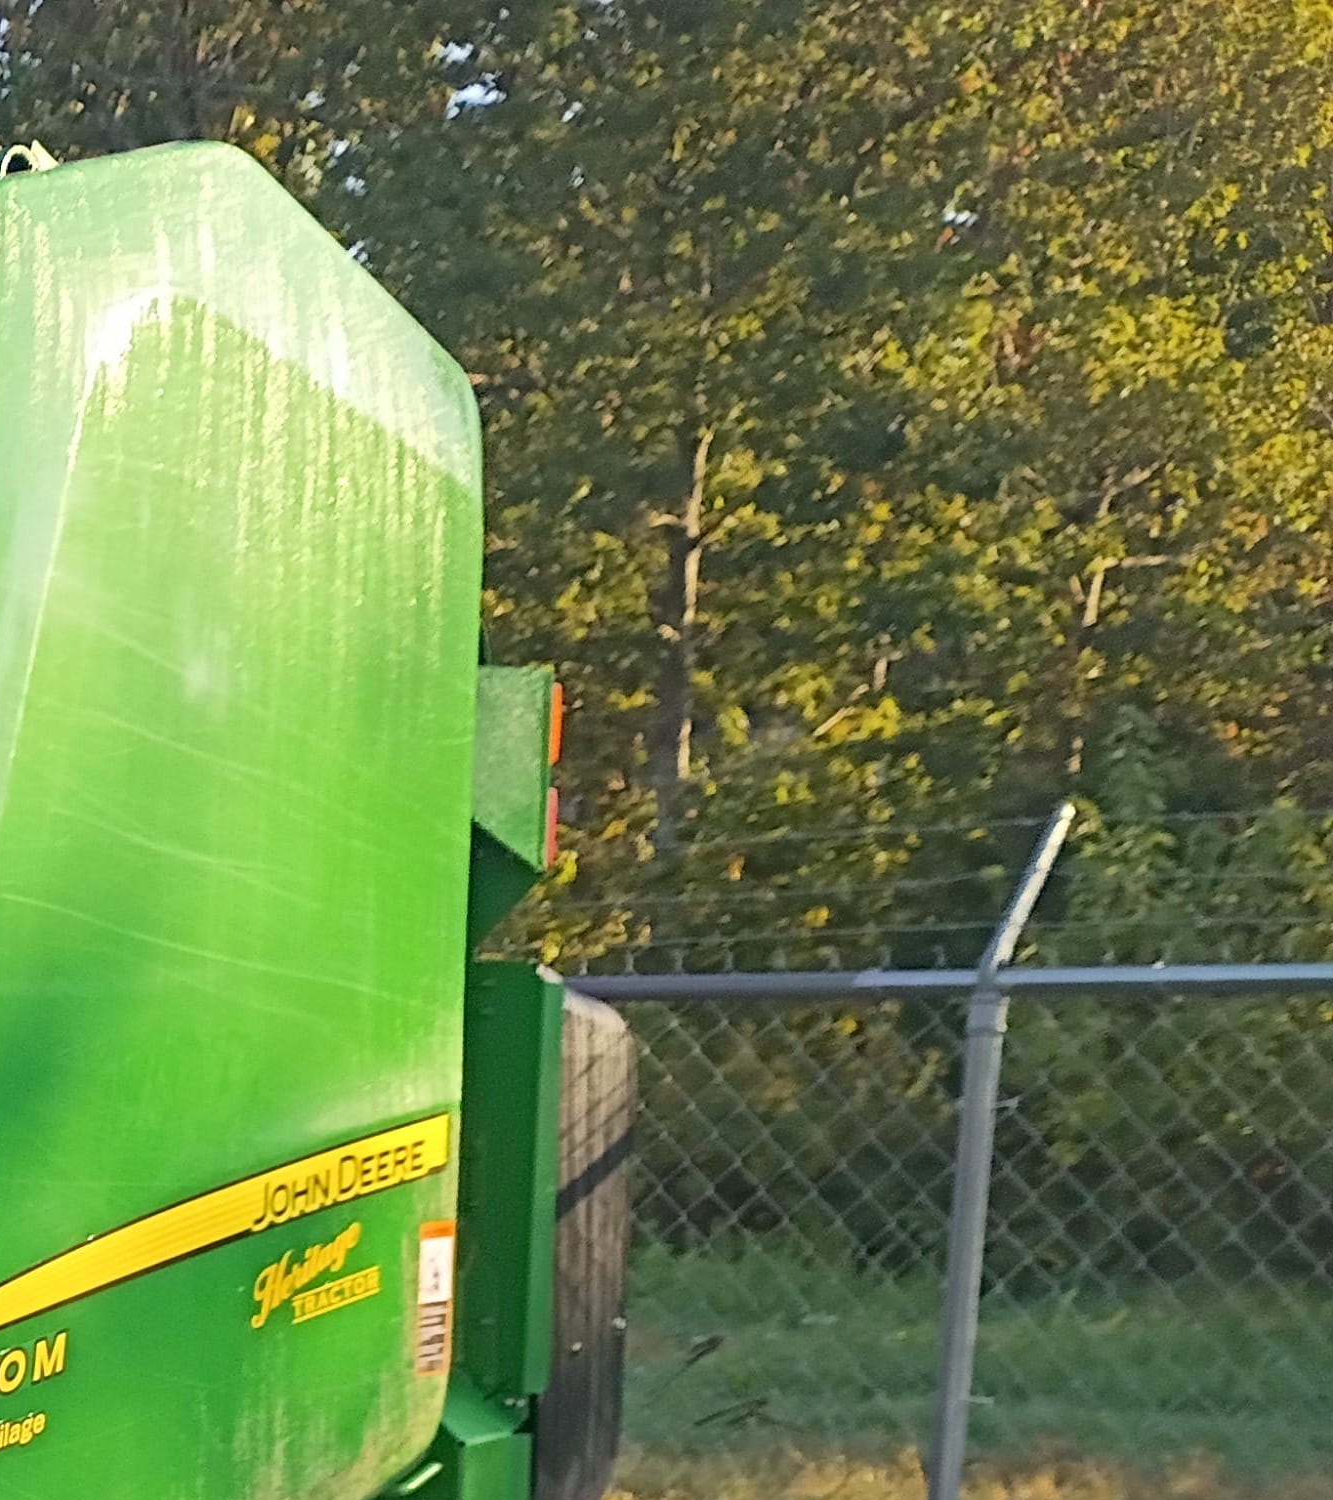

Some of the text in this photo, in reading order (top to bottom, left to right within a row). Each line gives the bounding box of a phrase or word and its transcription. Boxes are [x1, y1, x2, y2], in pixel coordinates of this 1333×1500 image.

[253, 1139, 426, 1225] JOHN DEERE
[250, 1221, 361, 1329] Heritage
[294, 1271, 380, 1317] TRACTOR
[32, 1331, 68, 1383] M
